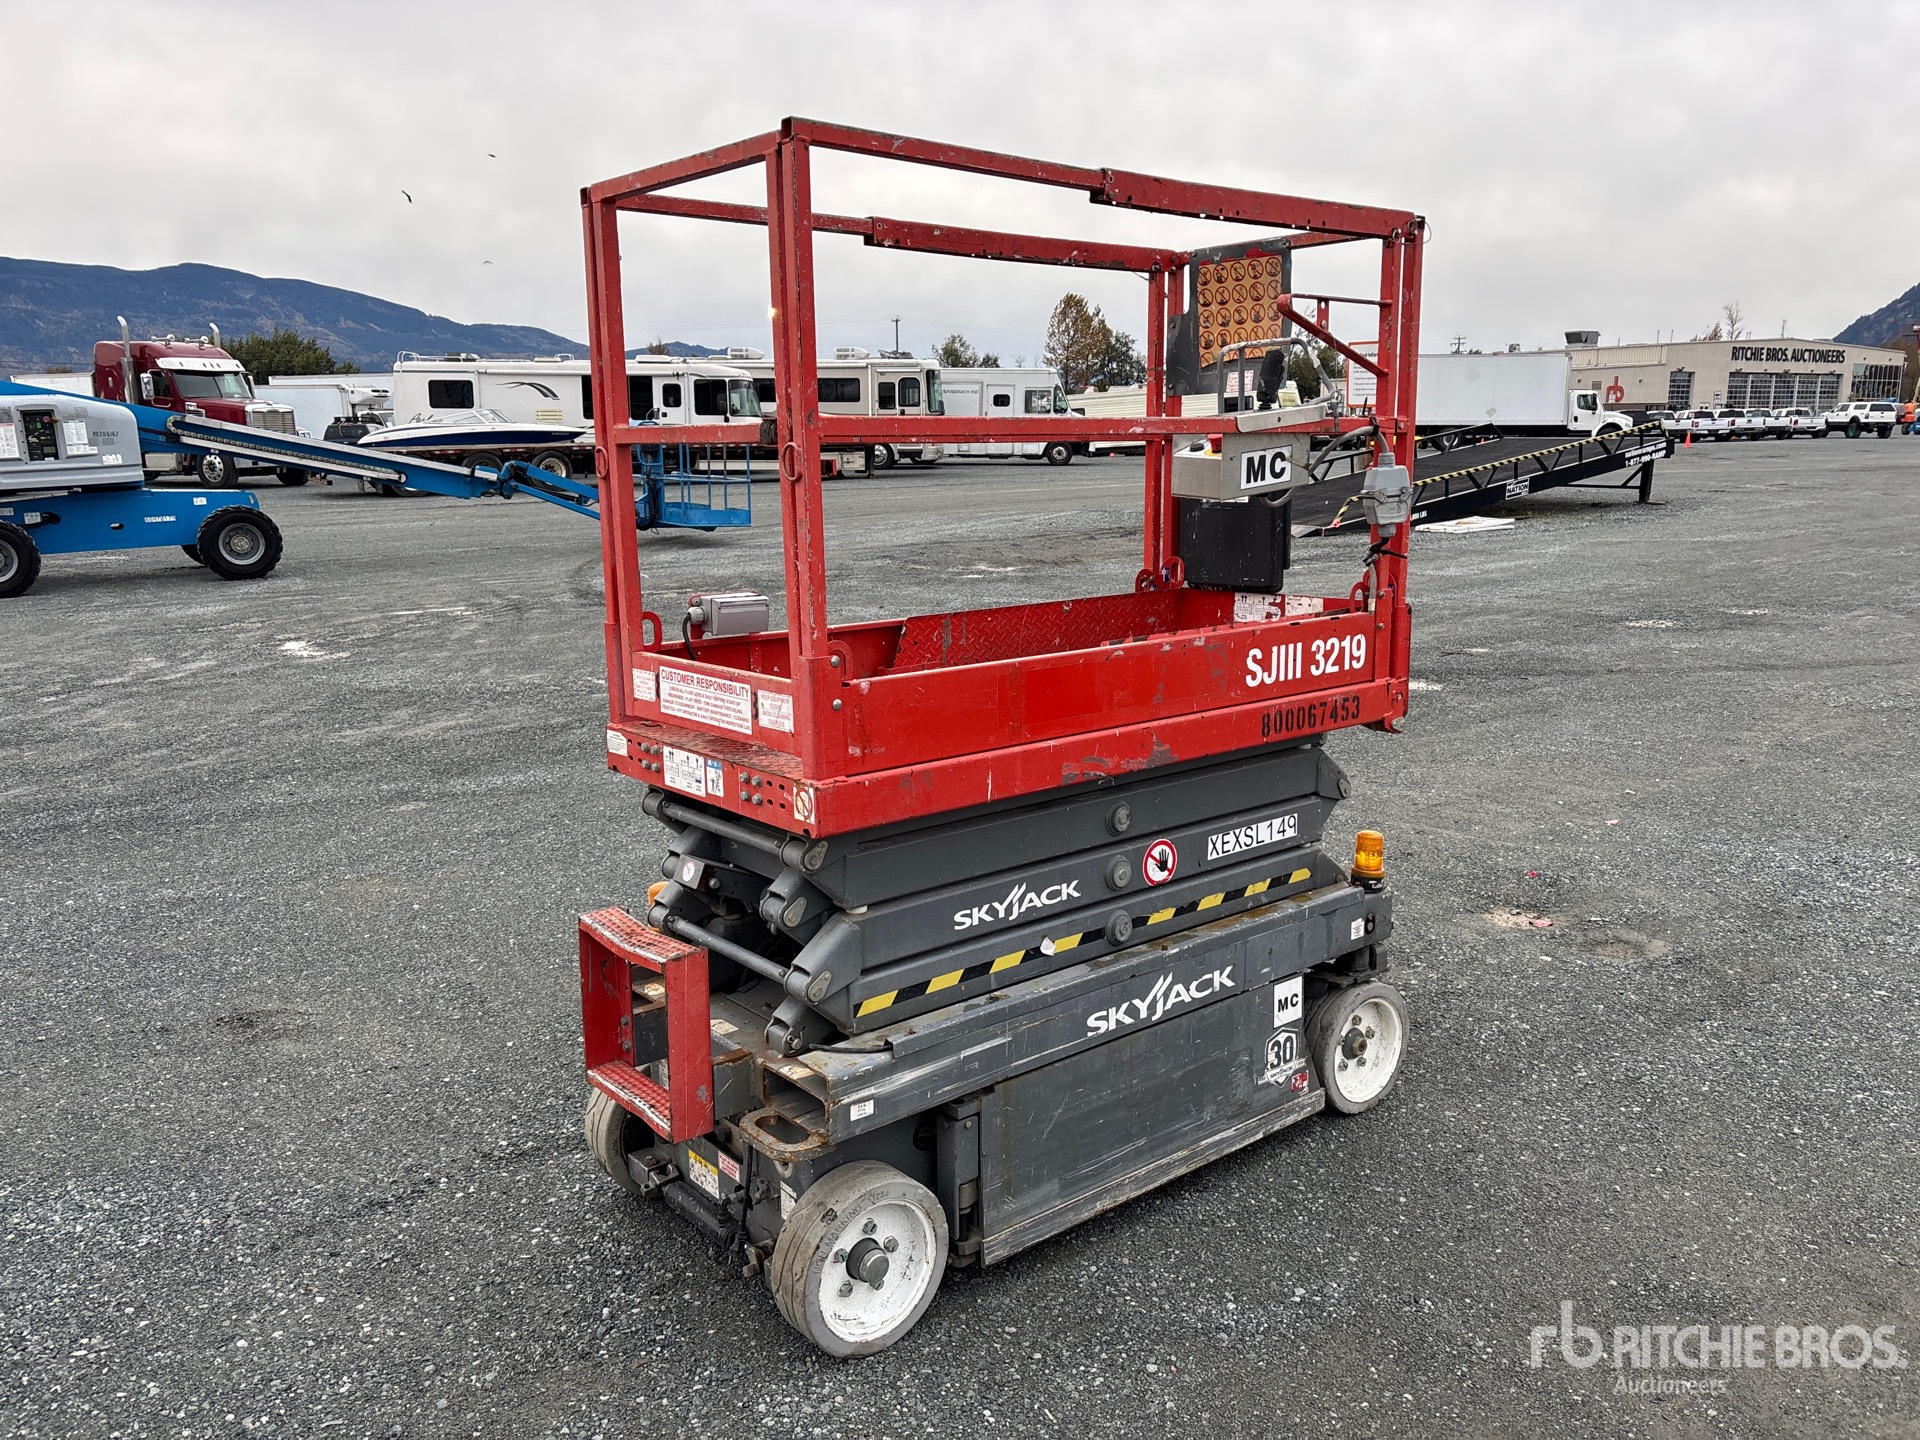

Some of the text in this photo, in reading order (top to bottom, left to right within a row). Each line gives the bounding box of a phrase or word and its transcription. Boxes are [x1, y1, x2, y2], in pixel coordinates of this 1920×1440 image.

[1731, 346, 1845, 364] RITCHIE BROS. AUCTIONEERS
[1624, 441, 1667, 459] nationramps.com
[1246, 452, 1286, 484] MC
[1506, 483, 1528, 494] NATION
[1246, 634, 1366, 688] SJIII 3219
[661, 669, 694, 686] CUSTOMER
[696, 676, 748, 698] RESPONSIBILITY
[1262, 696, 1360, 738] 800067453
[954, 880, 1082, 930] SKYJACK
[1086, 966, 1236, 1036] SKYJACK
[1278, 994, 1299, 1014] MC
[1270, 1035, 1294, 1070] 30
[1270, 1066, 1293, 1078] SKYJACK
[812, 1204, 862, 1274] NON MARKING
